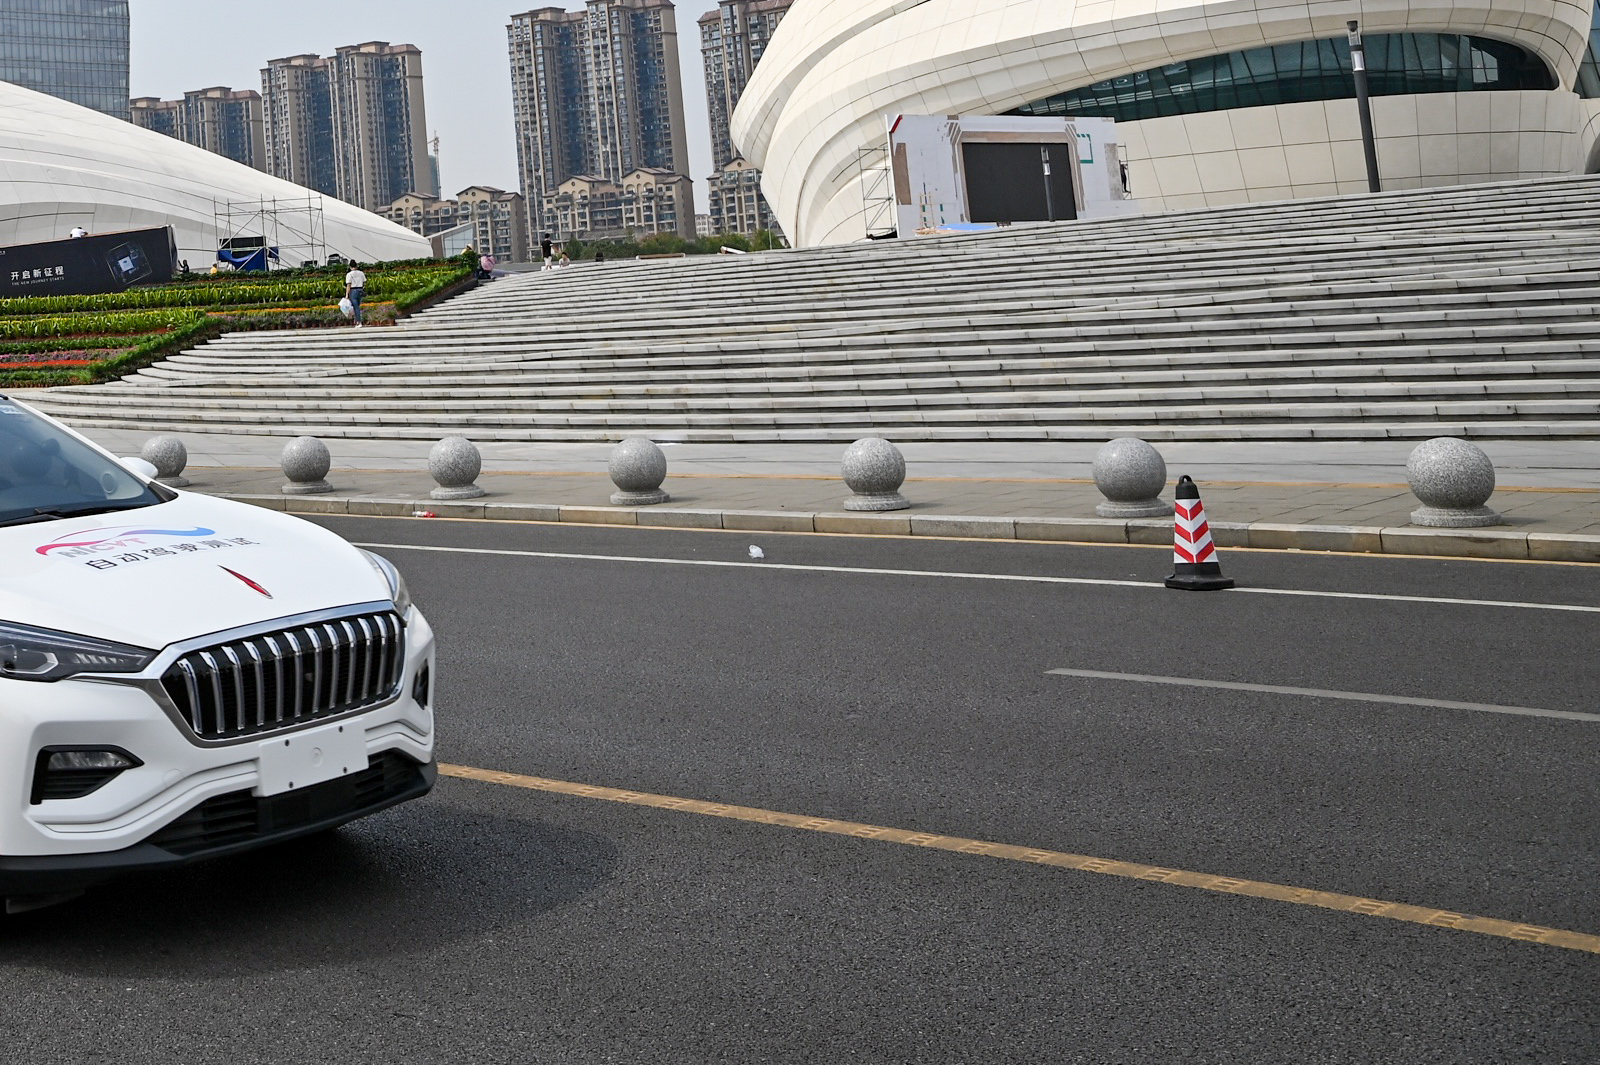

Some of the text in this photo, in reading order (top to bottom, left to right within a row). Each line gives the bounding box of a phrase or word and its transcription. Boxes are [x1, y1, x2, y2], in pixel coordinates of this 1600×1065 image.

[11, 266, 64, 281] 开启新征程
[84, 537, 260, 570] 自动驾驶测试
